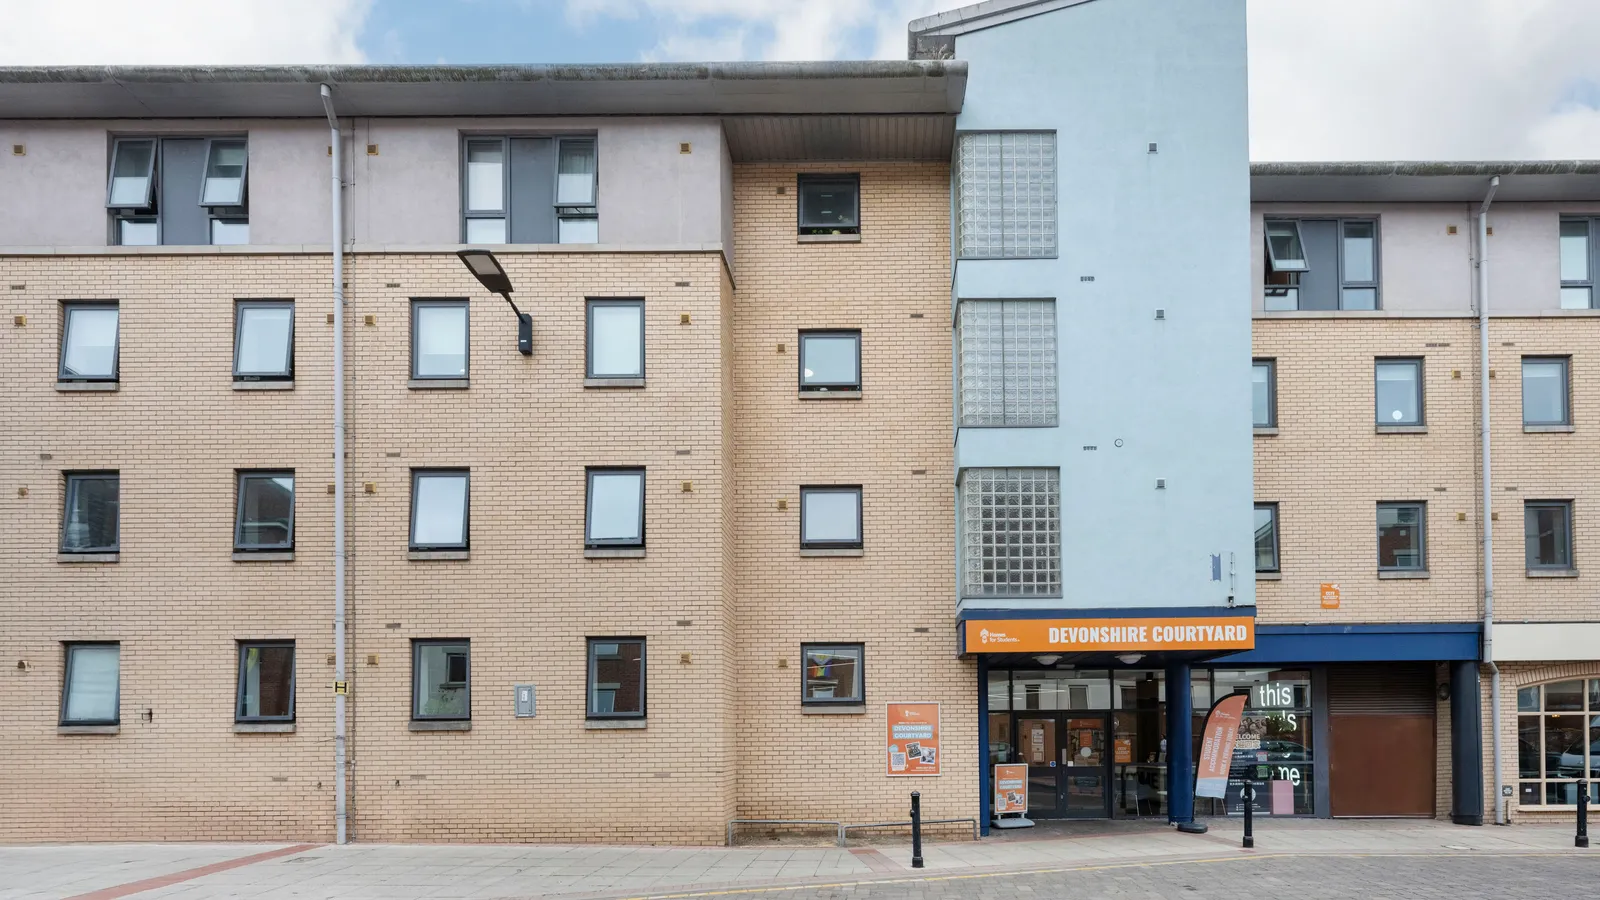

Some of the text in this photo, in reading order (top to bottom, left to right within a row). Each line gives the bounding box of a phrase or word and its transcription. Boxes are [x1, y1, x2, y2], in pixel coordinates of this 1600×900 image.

[1049, 625, 1246, 644] DEVONSHIRE COURTYARD
[334, 682, 346, 694] H
[1260, 682, 1291, 706] this
[1204, 737, 1212, 760] STUDENT
[1208, 727, 1223, 772] ACCOMMODATION
